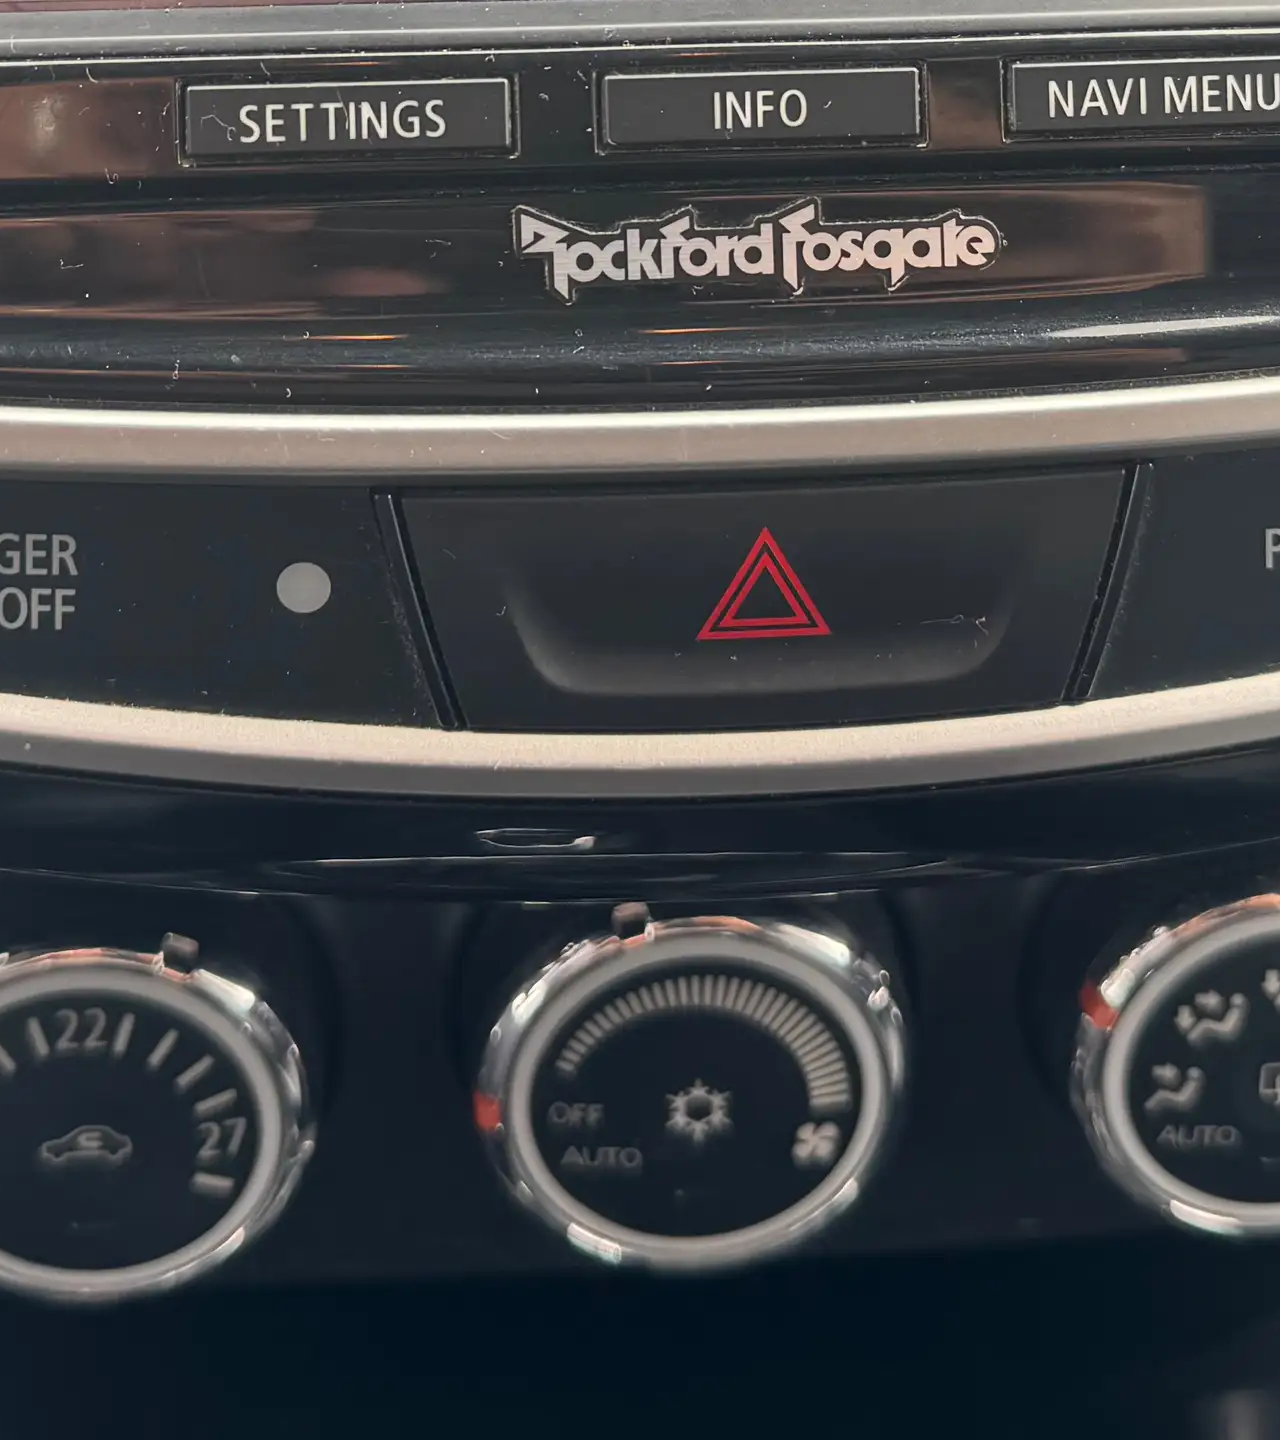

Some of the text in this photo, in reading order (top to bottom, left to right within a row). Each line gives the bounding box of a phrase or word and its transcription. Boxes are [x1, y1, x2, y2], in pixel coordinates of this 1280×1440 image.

[712, 89, 809, 130] INFO
[1047, 77, 1150, 119] NAVI
[239, 98, 447, 144] SETTINGS
[520, 203, 997, 301] Rockford Fosgate
[55, 1007, 109, 1050] 22
[546, 1101, 606, 1128] OFF
[196, 1117, 247, 1160] 27
[1158, 1124, 1238, 1148] AUTO
[558, 1143, 644, 1172] AUTO
